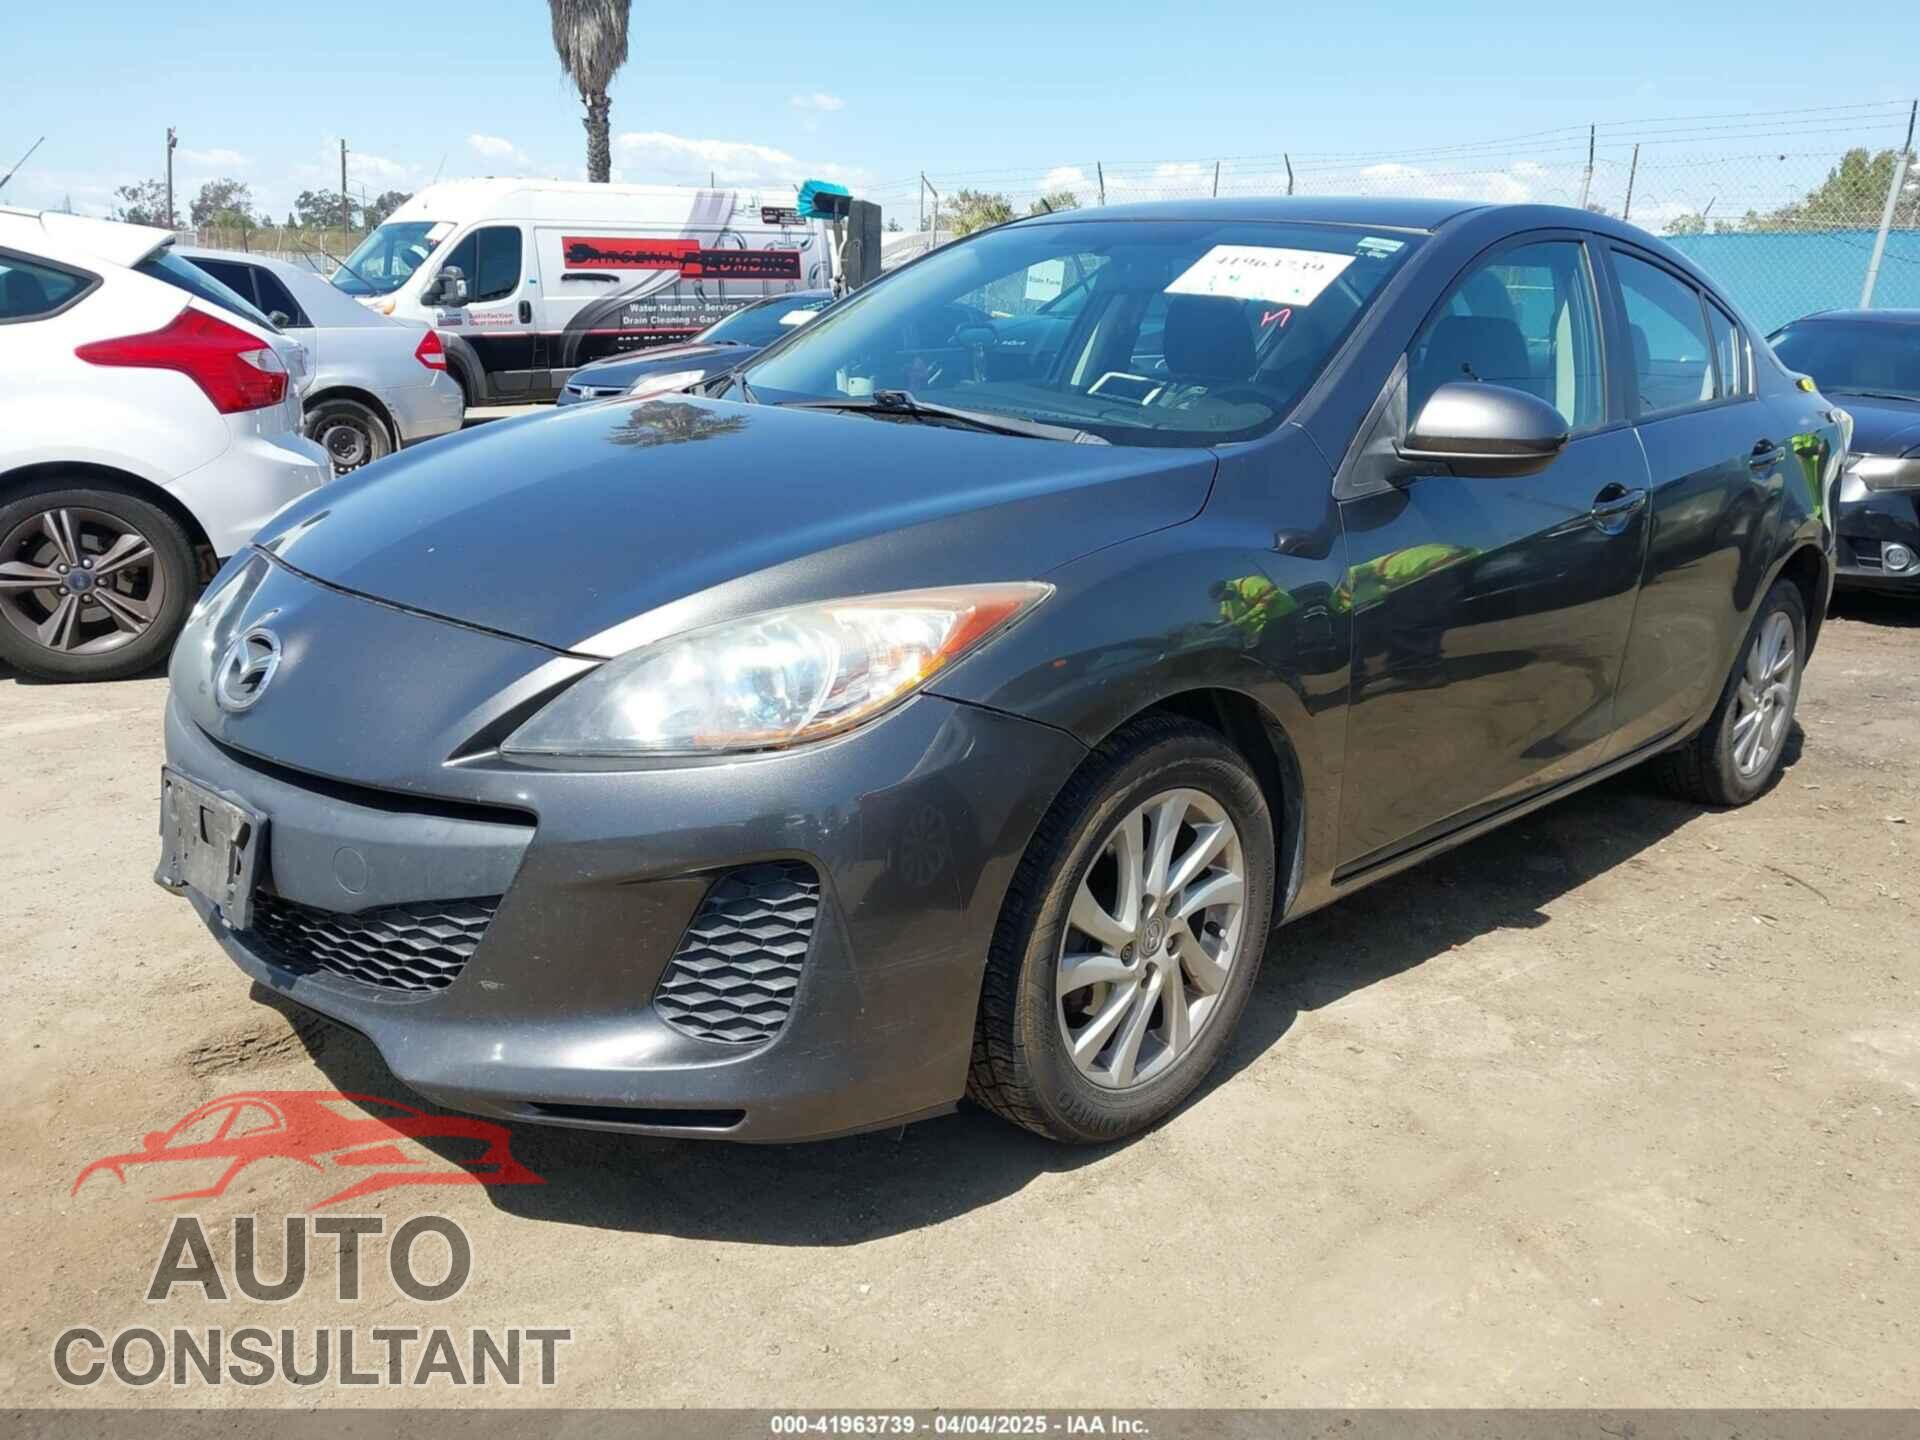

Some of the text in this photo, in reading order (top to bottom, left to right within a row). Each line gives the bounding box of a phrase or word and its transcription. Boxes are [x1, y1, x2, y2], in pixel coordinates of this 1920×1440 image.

[630, 304, 657, 312] Water
[660, 304, 696, 312] Heaters
[623, 316, 648, 325] Drain
[651, 316, 690, 325] Cleaning
